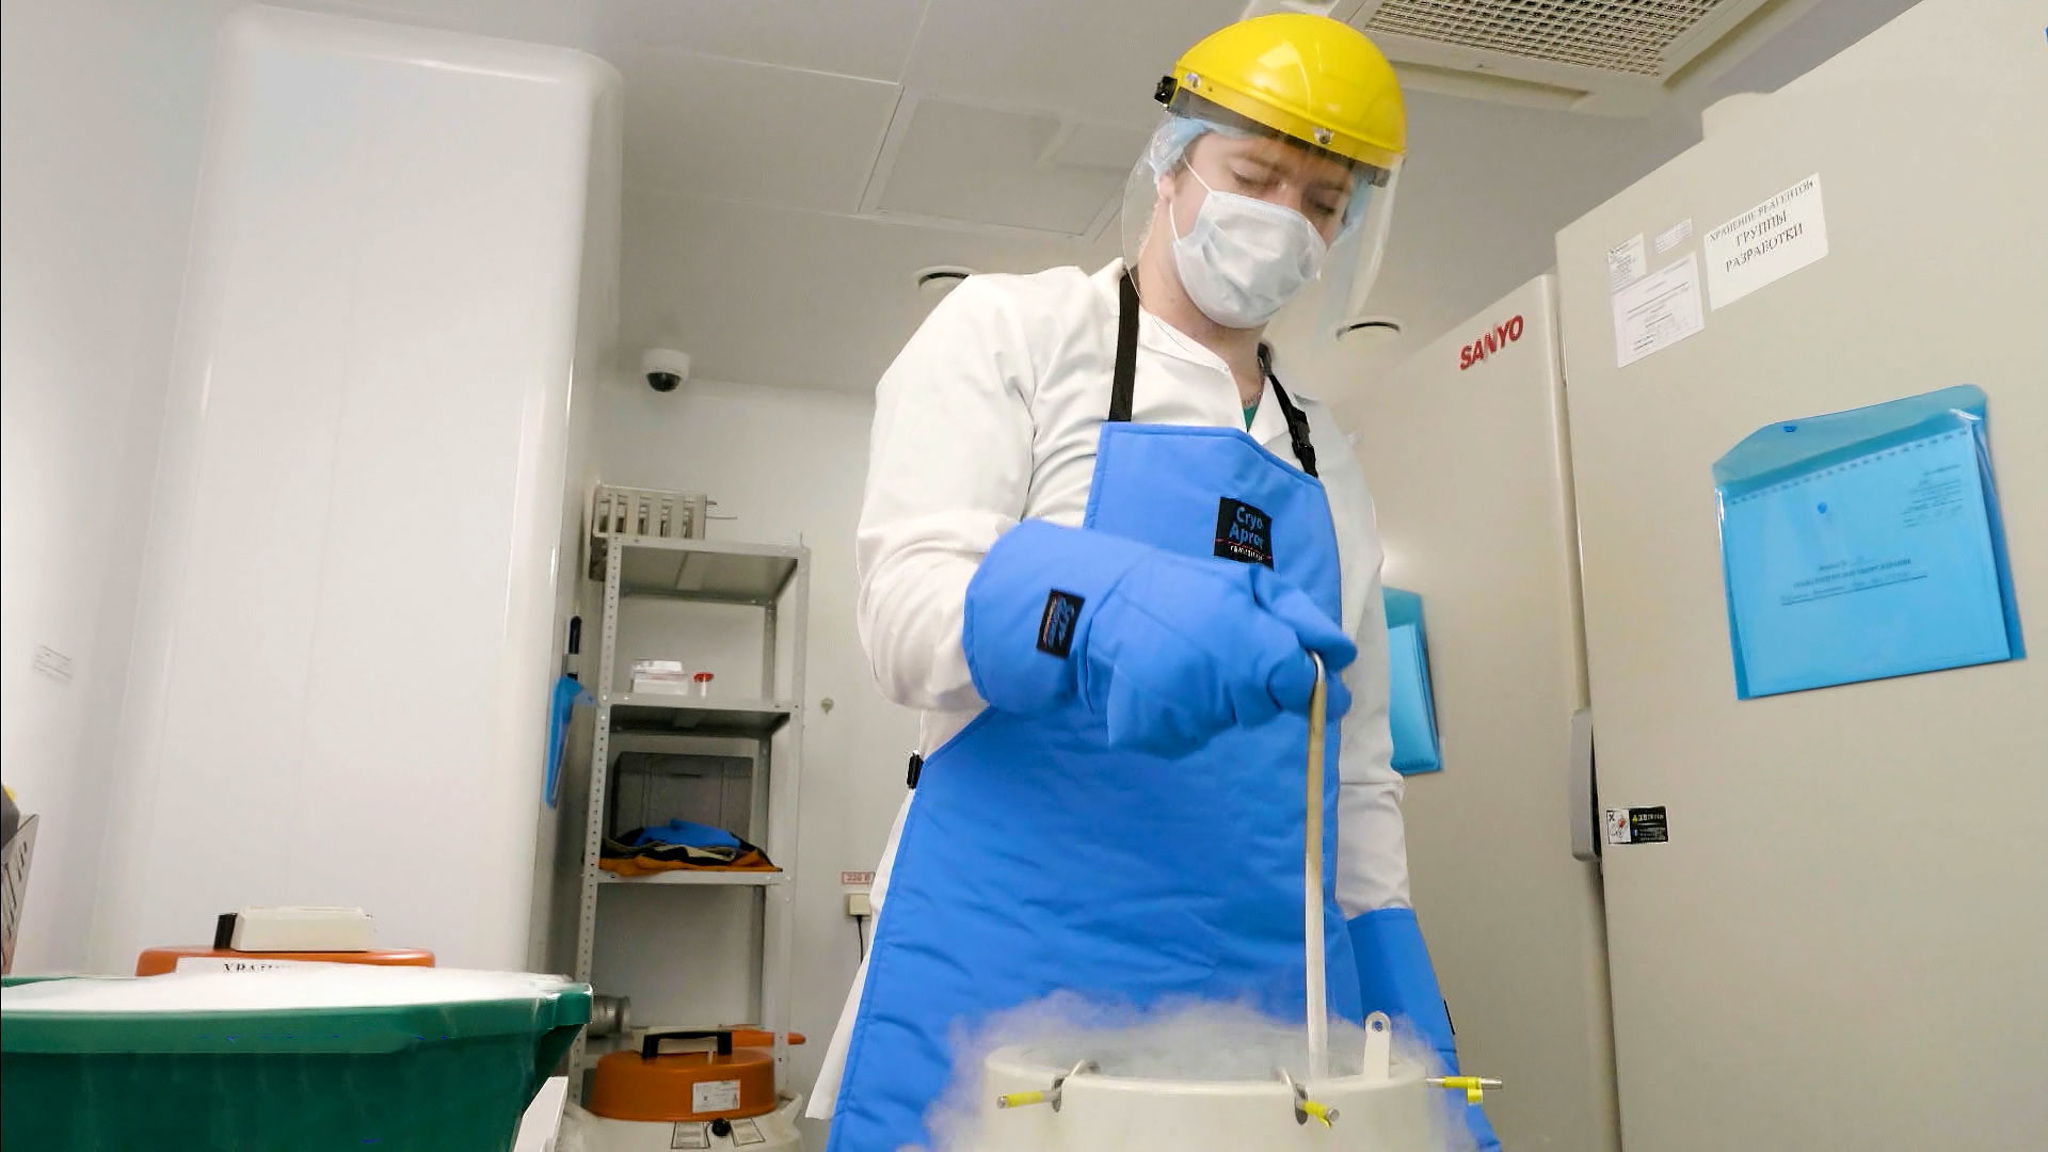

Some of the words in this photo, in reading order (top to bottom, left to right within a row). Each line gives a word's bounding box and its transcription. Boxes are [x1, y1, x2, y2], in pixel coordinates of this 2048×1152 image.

[1725, 222, 1803, 273] РАЗРАБОТКИ
[1735, 209, 1788, 247] ГРУППЫ
[1460, 314, 1523, 370] SANYO
[1236, 506, 1264, 531] Cryo
